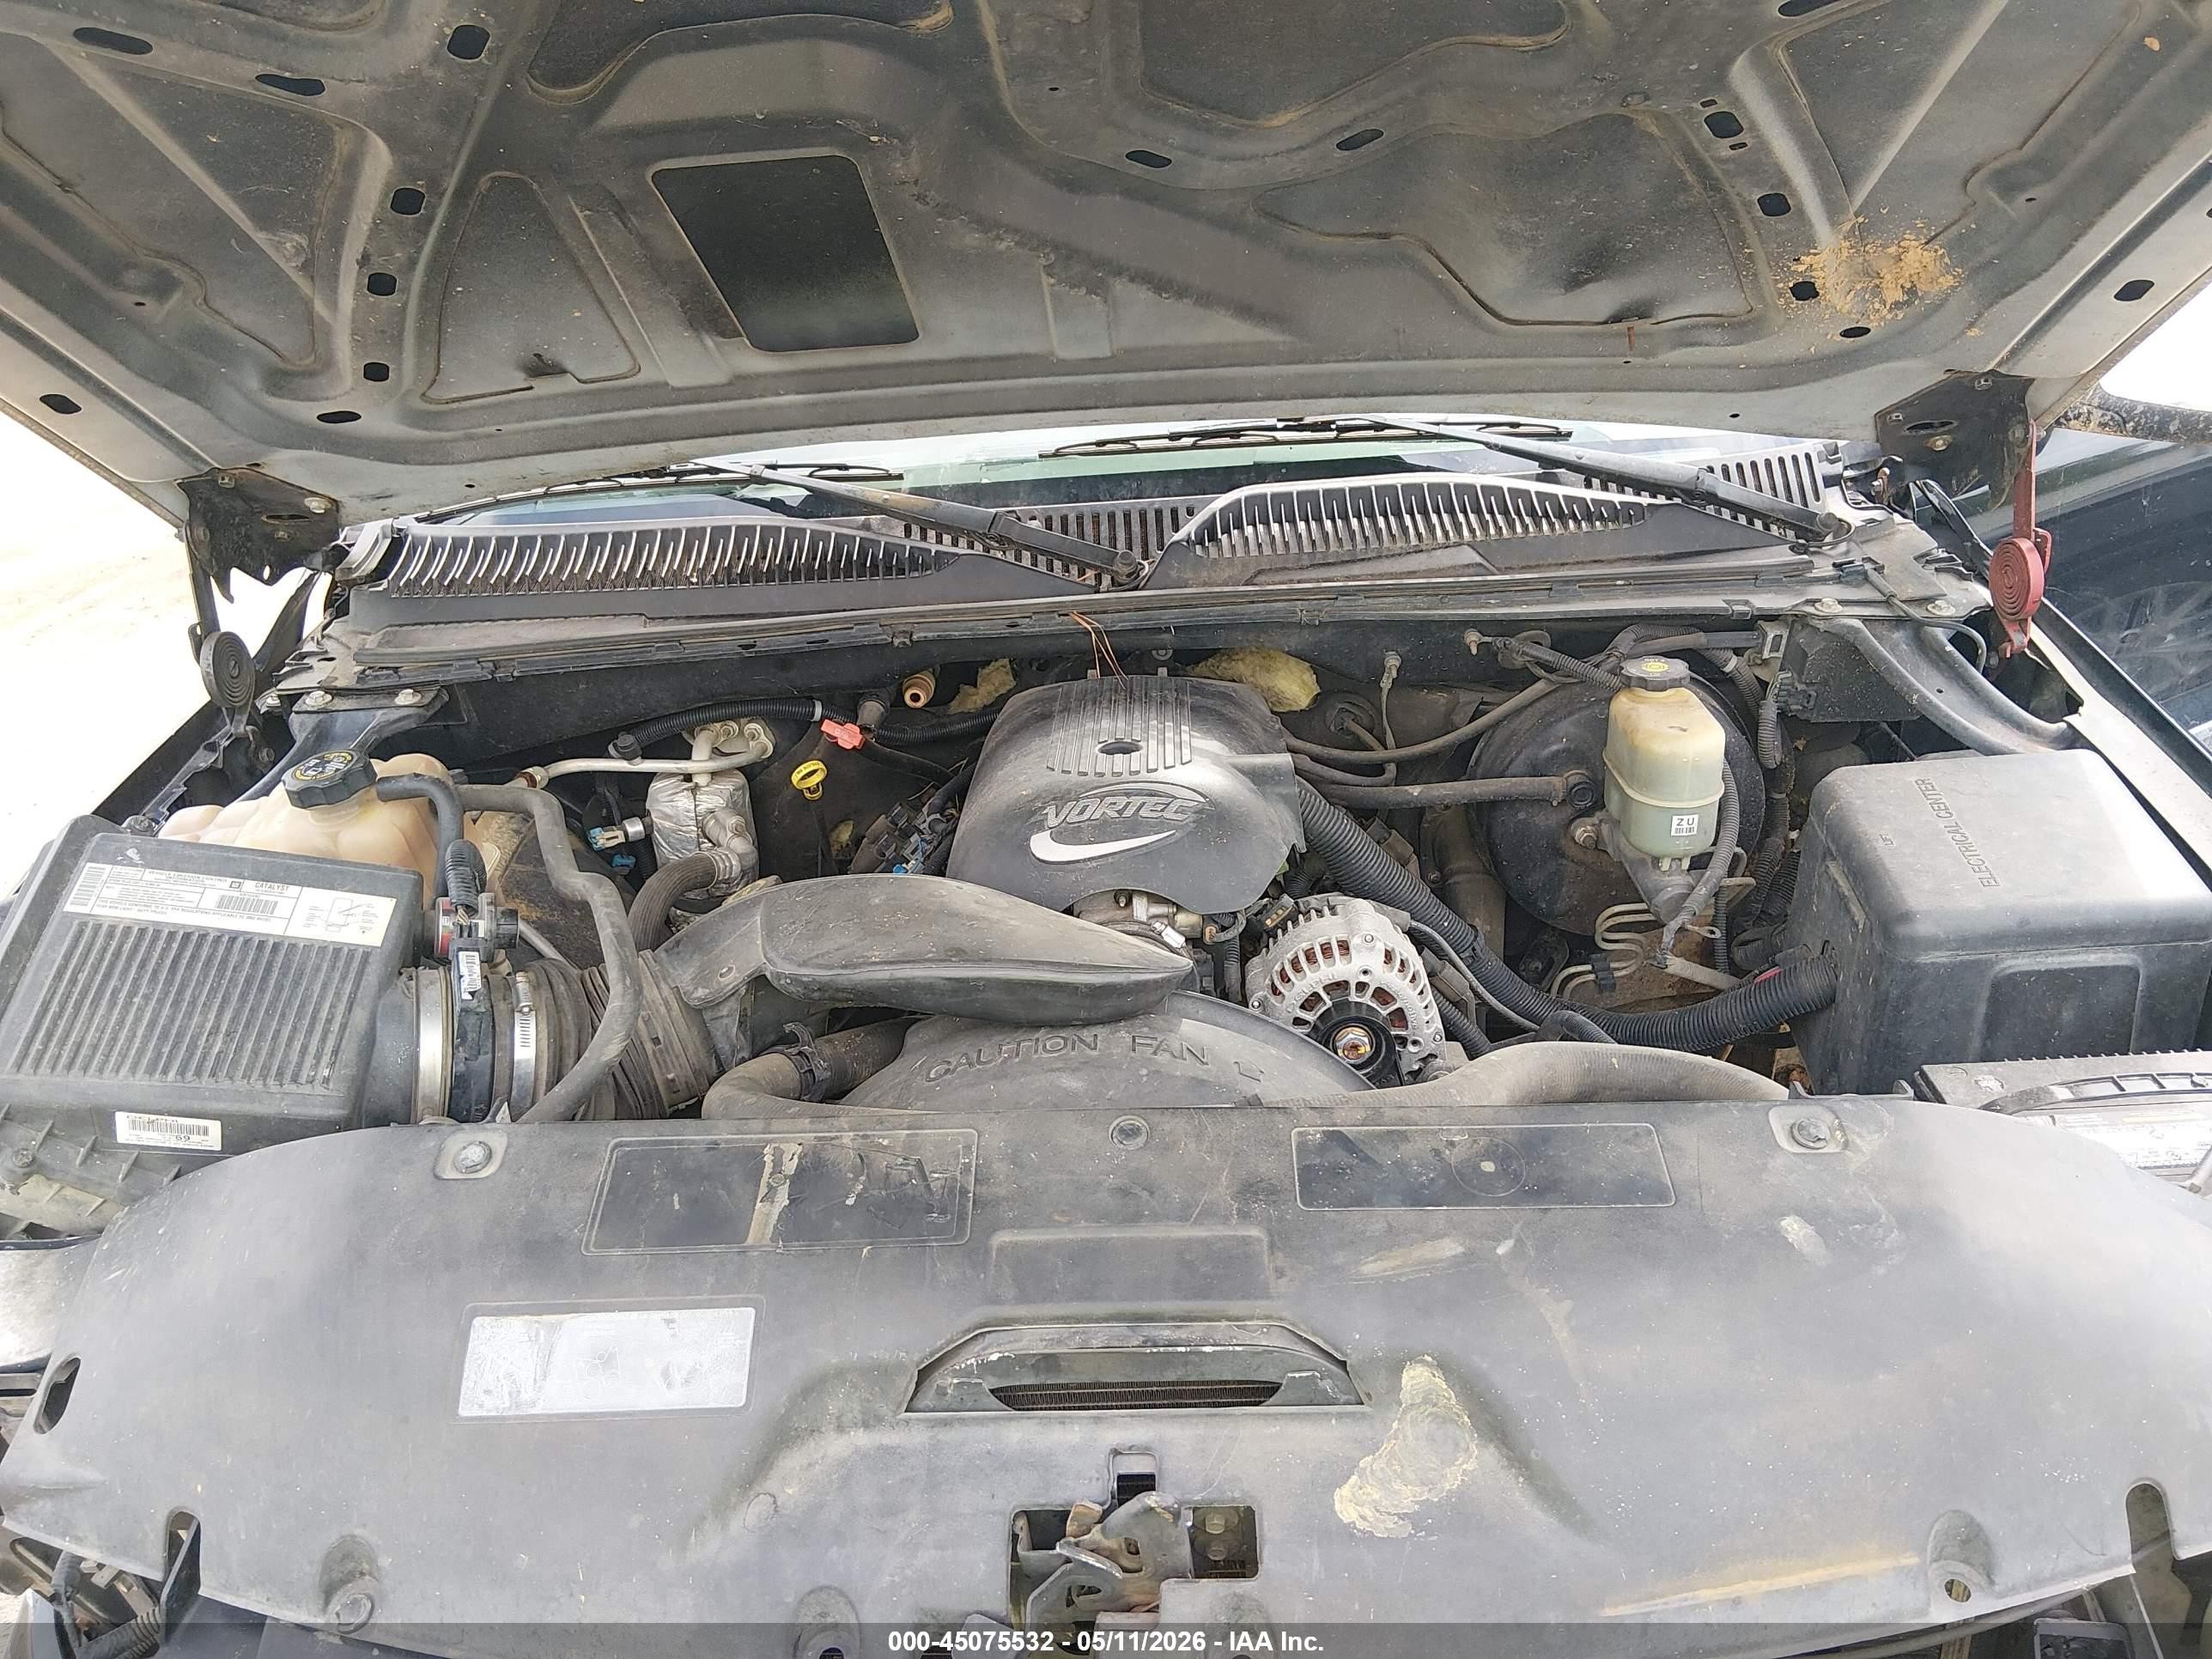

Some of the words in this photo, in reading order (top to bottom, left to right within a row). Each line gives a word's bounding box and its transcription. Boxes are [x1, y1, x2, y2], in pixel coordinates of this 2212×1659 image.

[1042, 795, 1201, 830] VORTEC
[1914, 778, 1954, 819] CENTER
[1944, 821, 2001, 888] ELECTRICAL
[255, 882, 290, 891] CATALYST
[925, 1033, 1099, 1082] CAUTION
[1131, 1034, 1210, 1066] FAN
